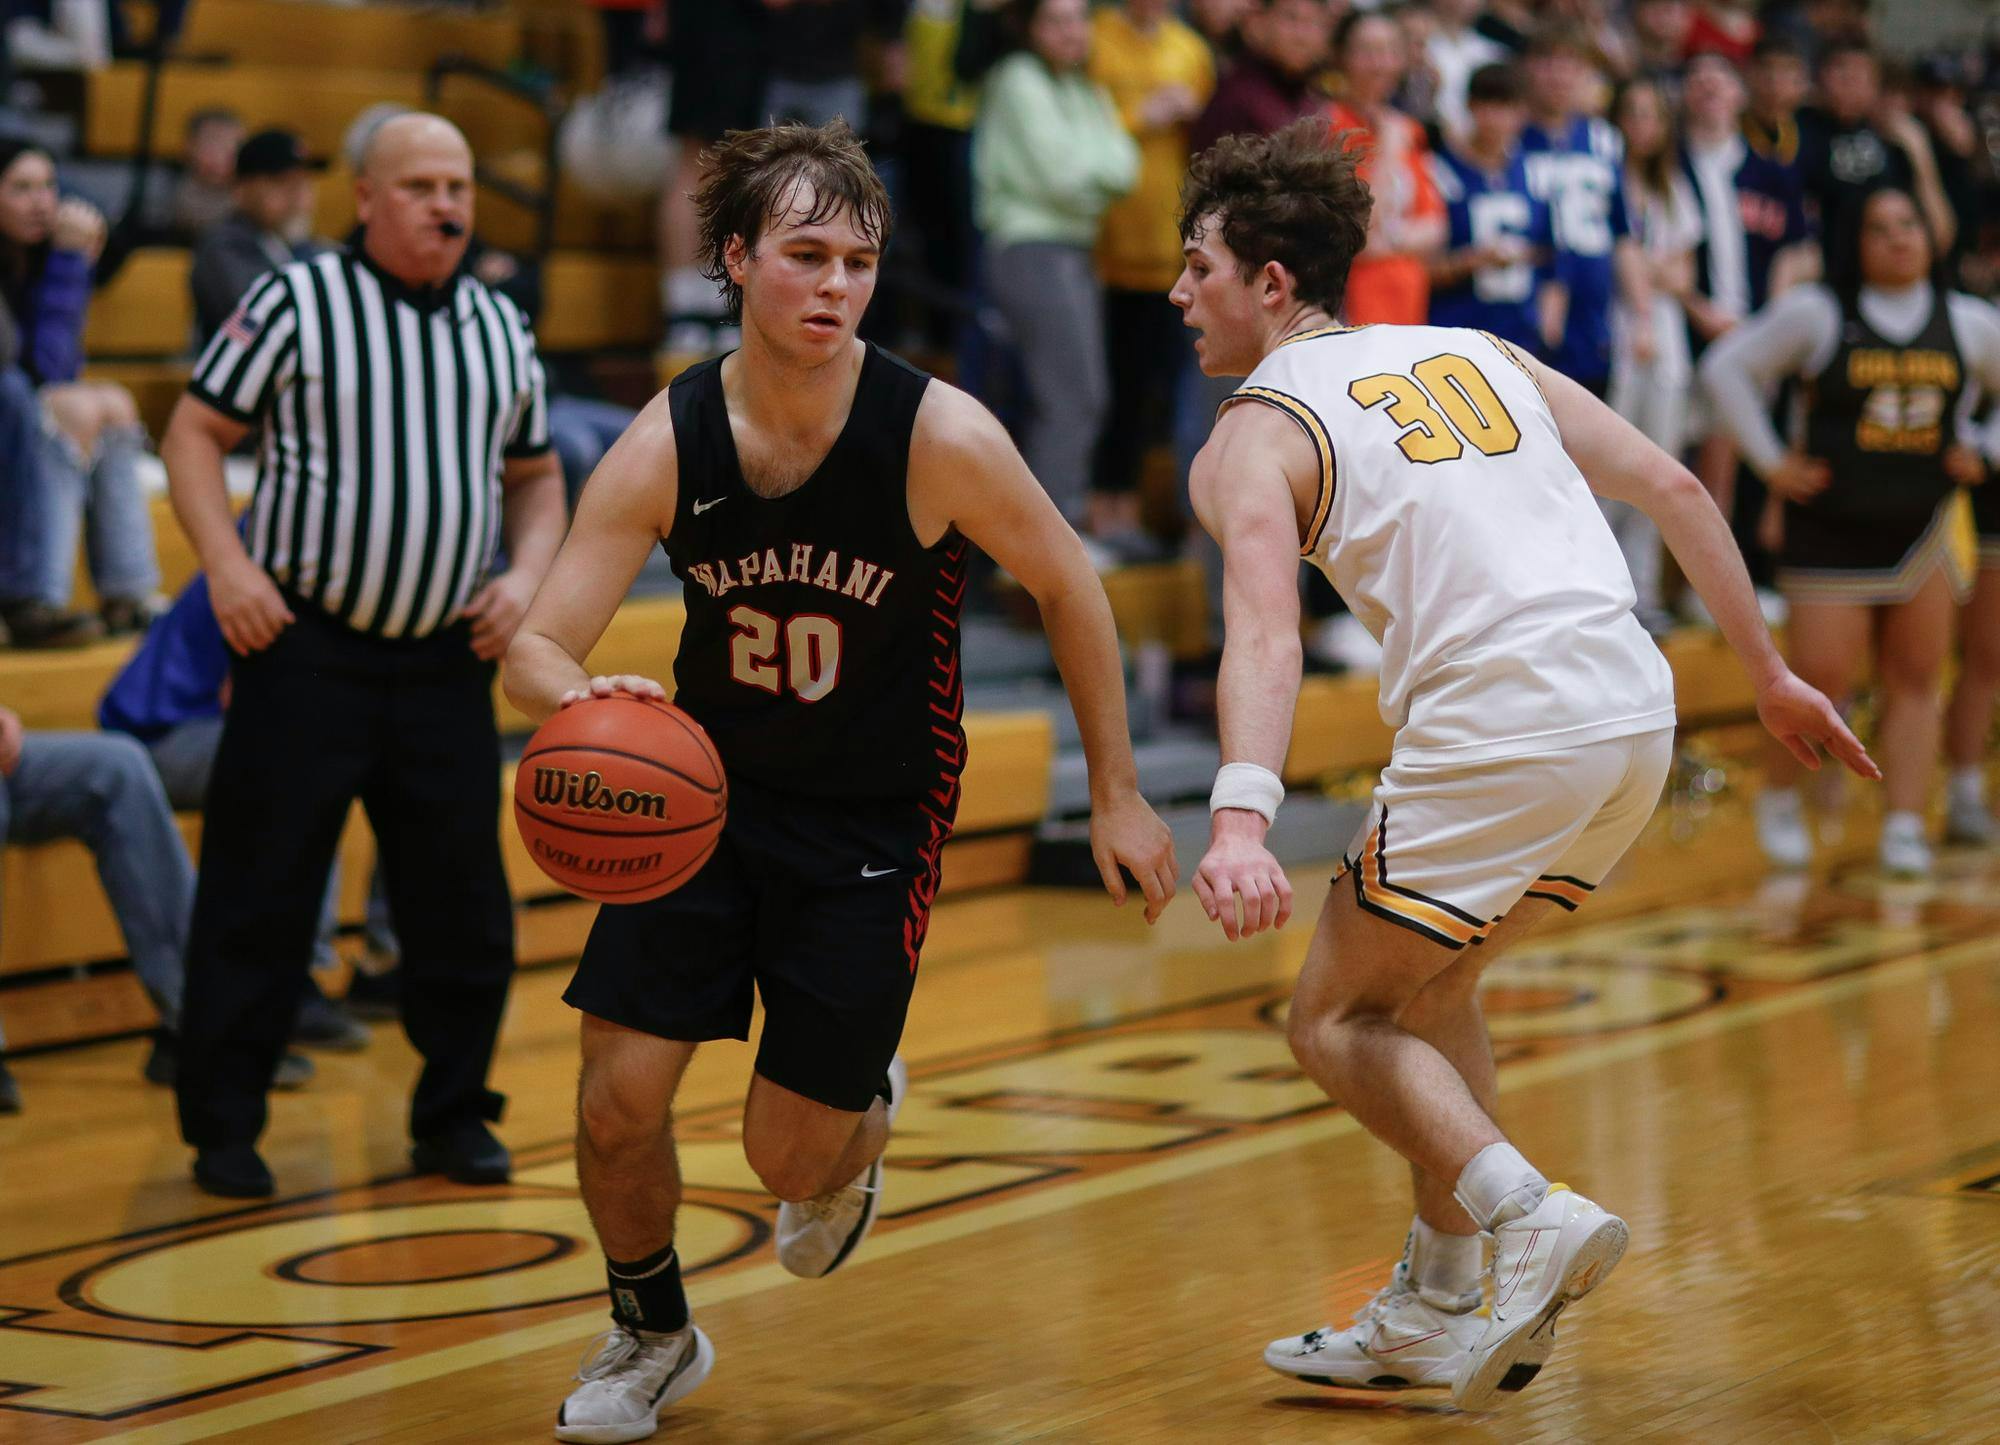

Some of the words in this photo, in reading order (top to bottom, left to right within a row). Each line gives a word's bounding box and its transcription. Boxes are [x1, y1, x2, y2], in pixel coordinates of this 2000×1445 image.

[1347, 353, 1521, 464] 30
[687, 543, 895, 606] WAPAHANI
[727, 604, 842, 703] 20
[534, 768, 666, 821] Wilson
[534, 838, 664, 876] EVOLUTION
